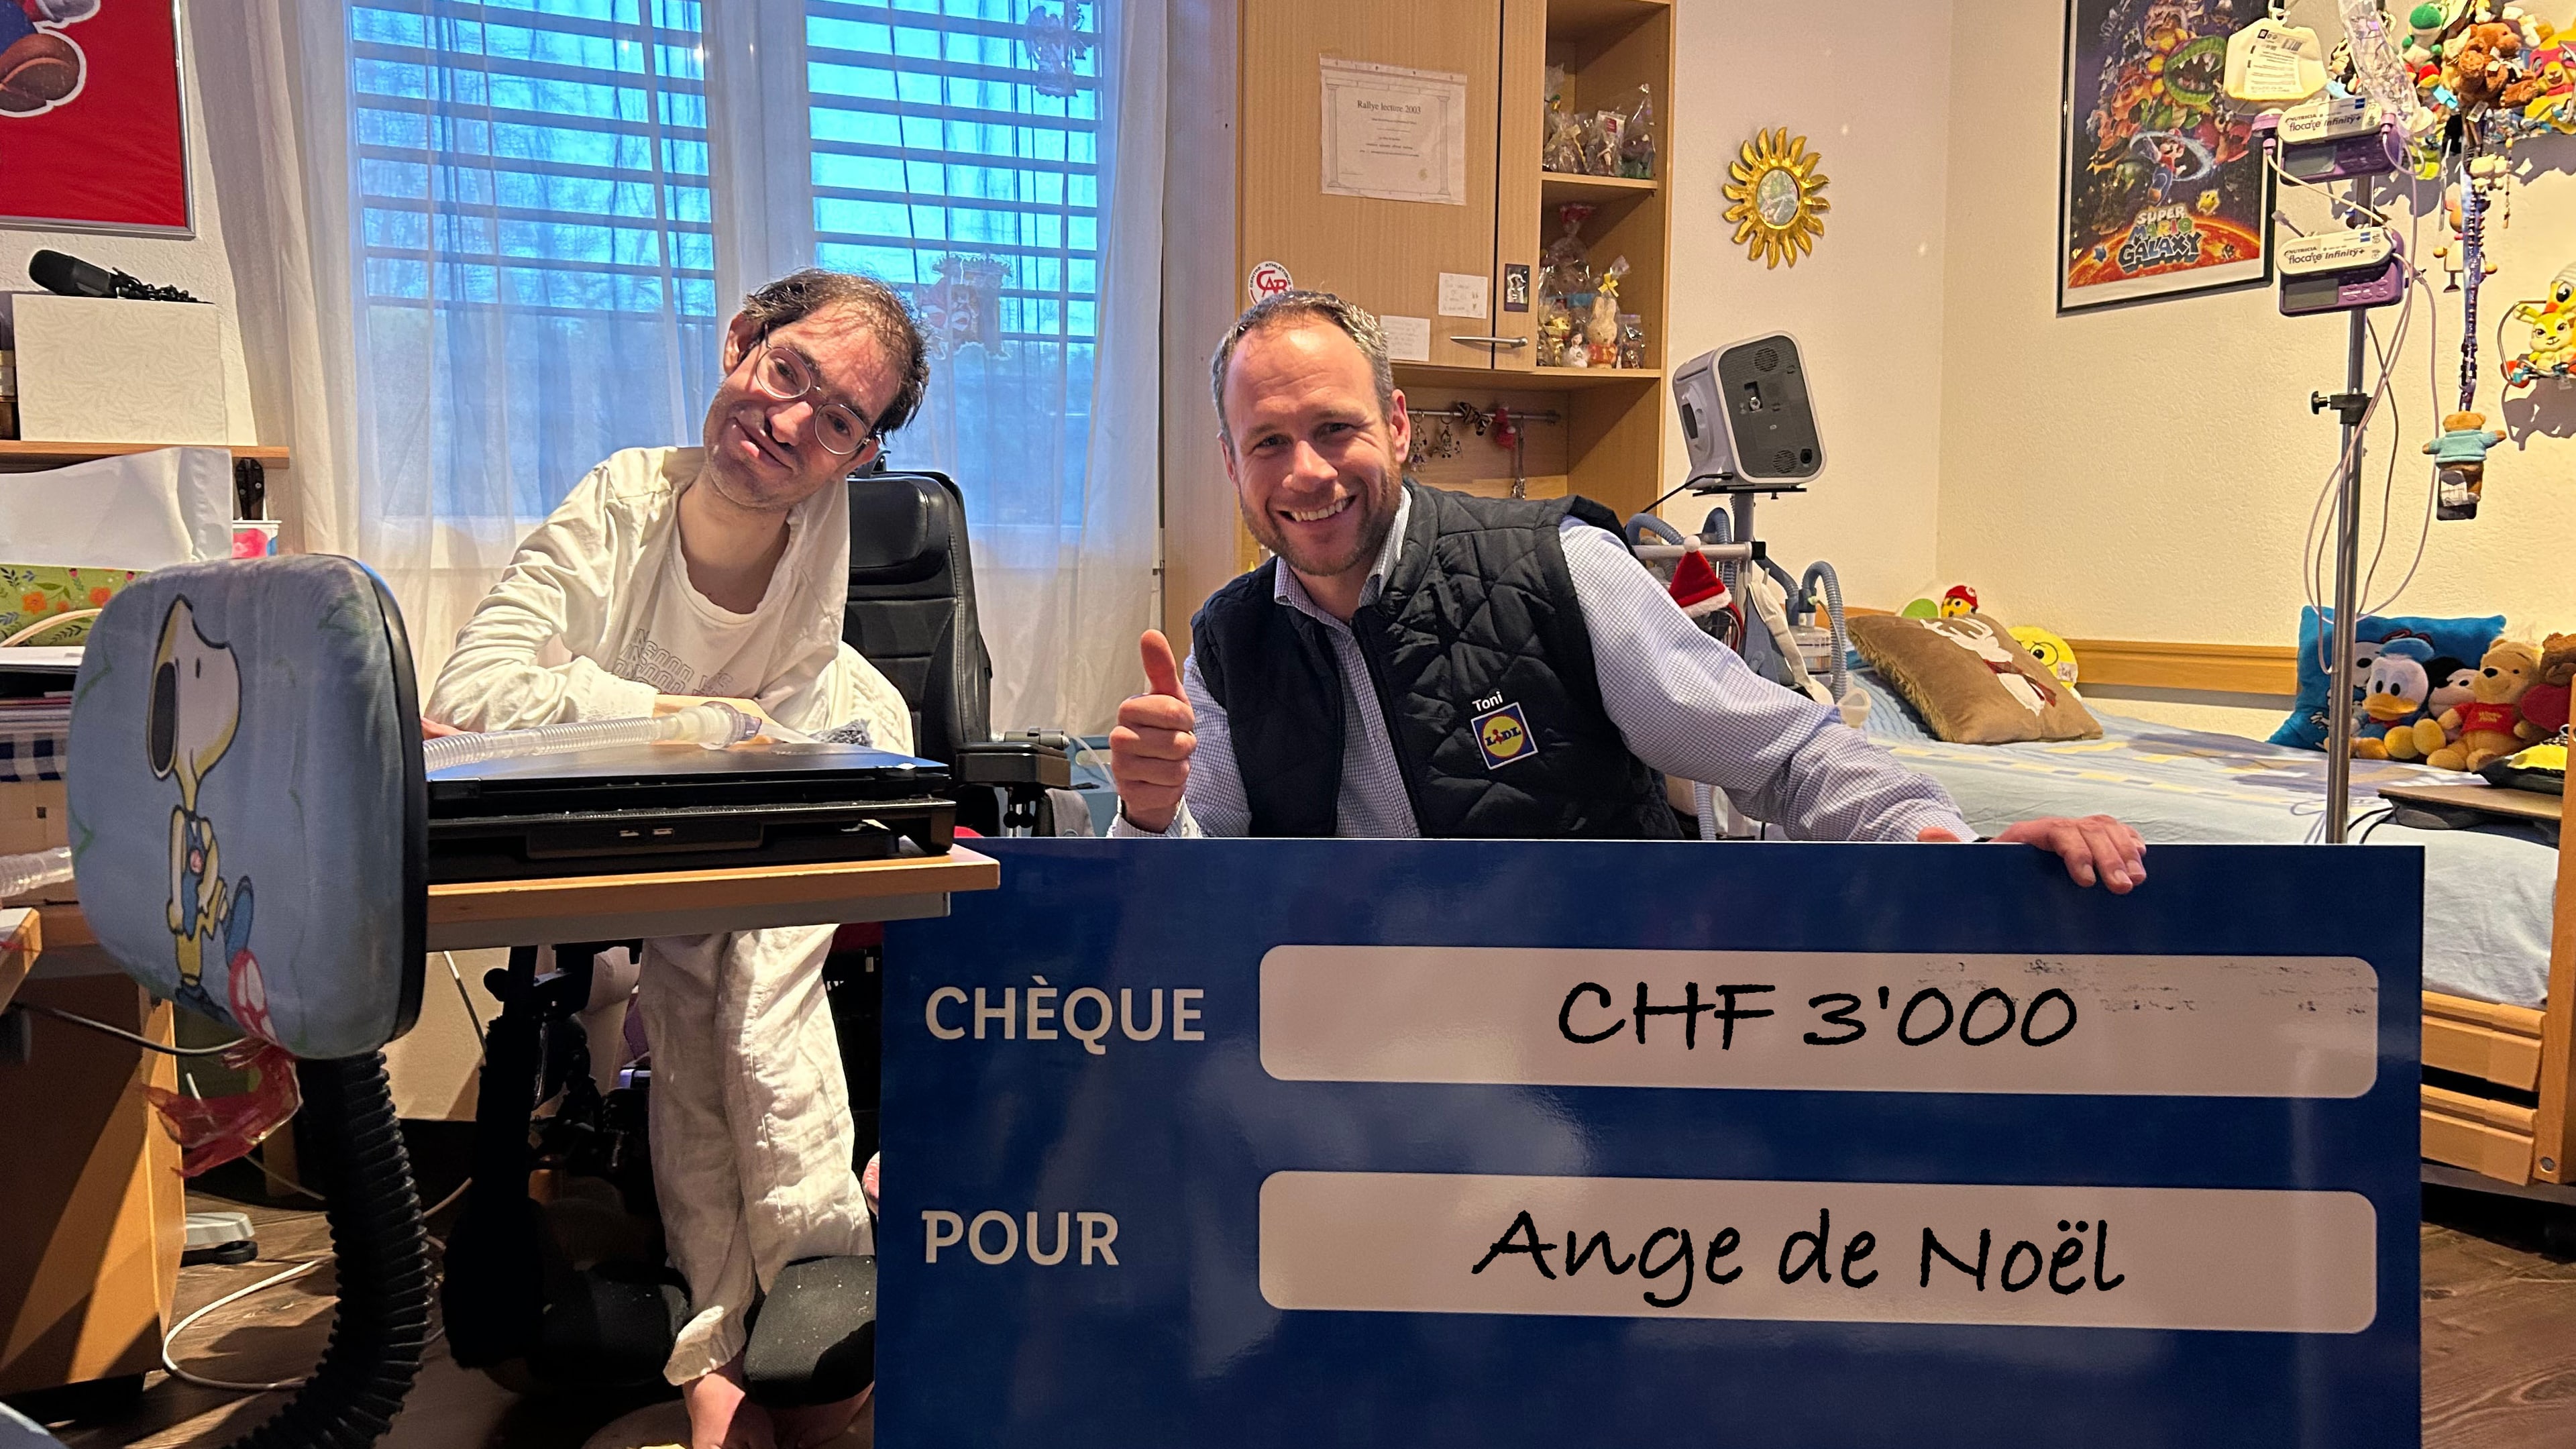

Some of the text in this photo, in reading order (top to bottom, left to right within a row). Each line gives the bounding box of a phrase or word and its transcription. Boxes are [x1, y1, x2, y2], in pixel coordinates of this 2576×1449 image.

[1357, 100, 1421, 115] Rallye lecture 2003
[2128, 217, 2193, 244] MARIO
[2137, 206, 2184, 225] SUPER
[2118, 231, 2202, 270] GALAXY
[1472, 691, 1503, 712] Toni
[926, 975, 1205, 1055] CHÈQUE
[1558, 981, 2078, 1051] CHF 3'000
[922, 1210, 1120, 1266] POUR
[1471, 1208, 2125, 1308] Ange de Noël
